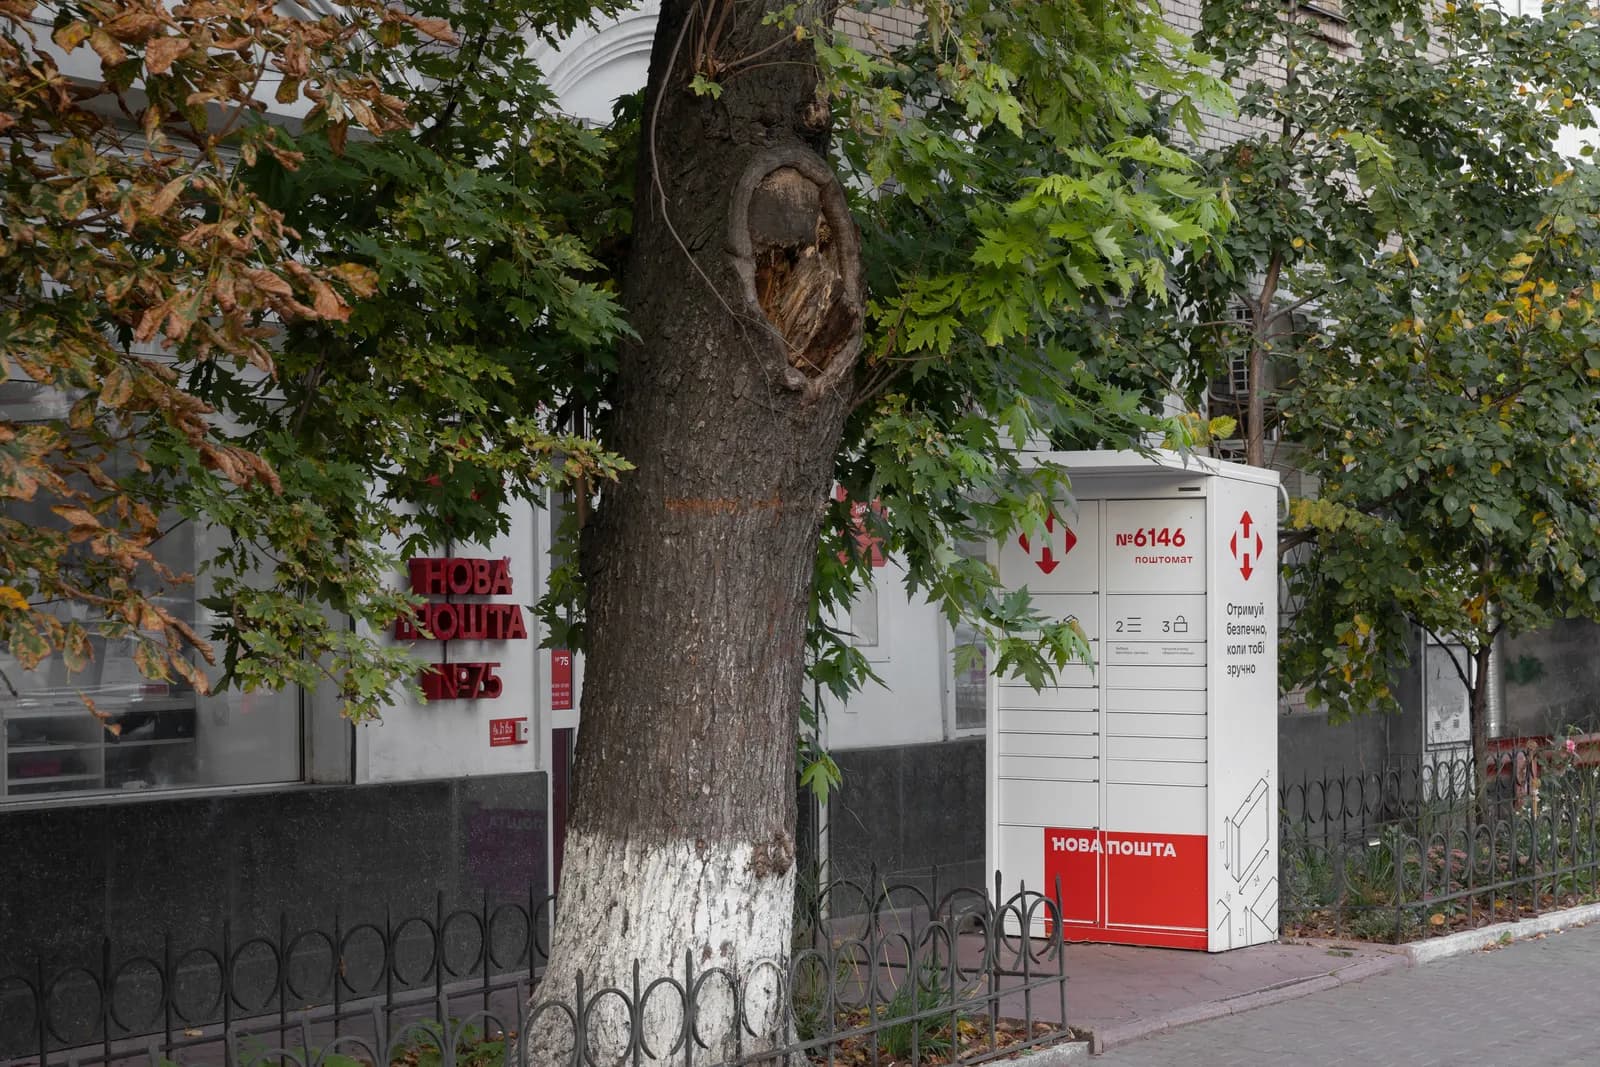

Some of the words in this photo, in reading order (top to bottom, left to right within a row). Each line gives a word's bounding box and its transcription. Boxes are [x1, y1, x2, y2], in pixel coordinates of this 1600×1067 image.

[1115, 528, 1186, 547] №6146
[1135, 556, 1193, 564] поштомат
[419, 558, 513, 595] НОВА
[1226, 602, 1265, 618] Отримуй
[1115, 620, 1124, 633] 2
[1162, 620, 1170, 633] 3
[1226, 622, 1268, 638] безпечно,
[1226, 644, 1247, 655] коли
[1248, 641, 1265, 655] тобі
[1226, 664, 1256, 678] зручно
[1051, 837, 1104, 854] НОВА
[1106, 840, 1177, 857] ПОШТА
